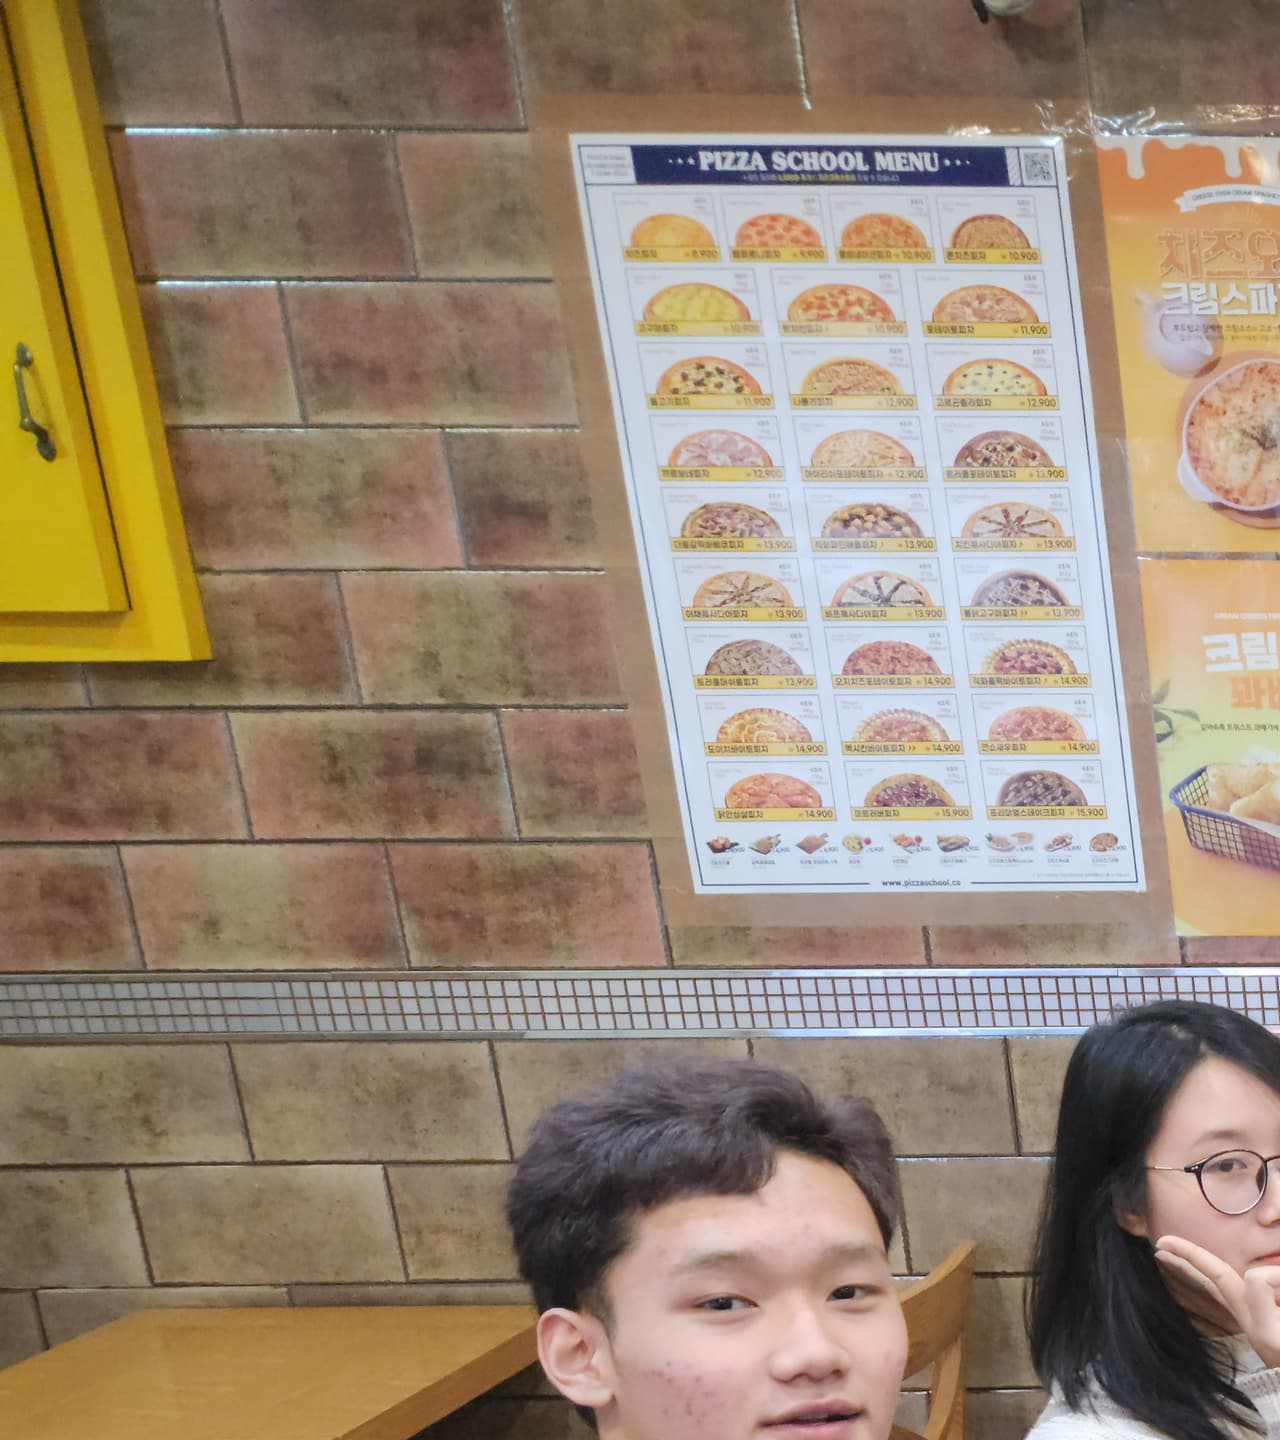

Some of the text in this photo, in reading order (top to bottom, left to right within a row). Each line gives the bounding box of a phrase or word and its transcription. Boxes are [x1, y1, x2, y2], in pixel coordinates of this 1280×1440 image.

[698, 151, 940, 172] PIZZA SCHOOL MENU
